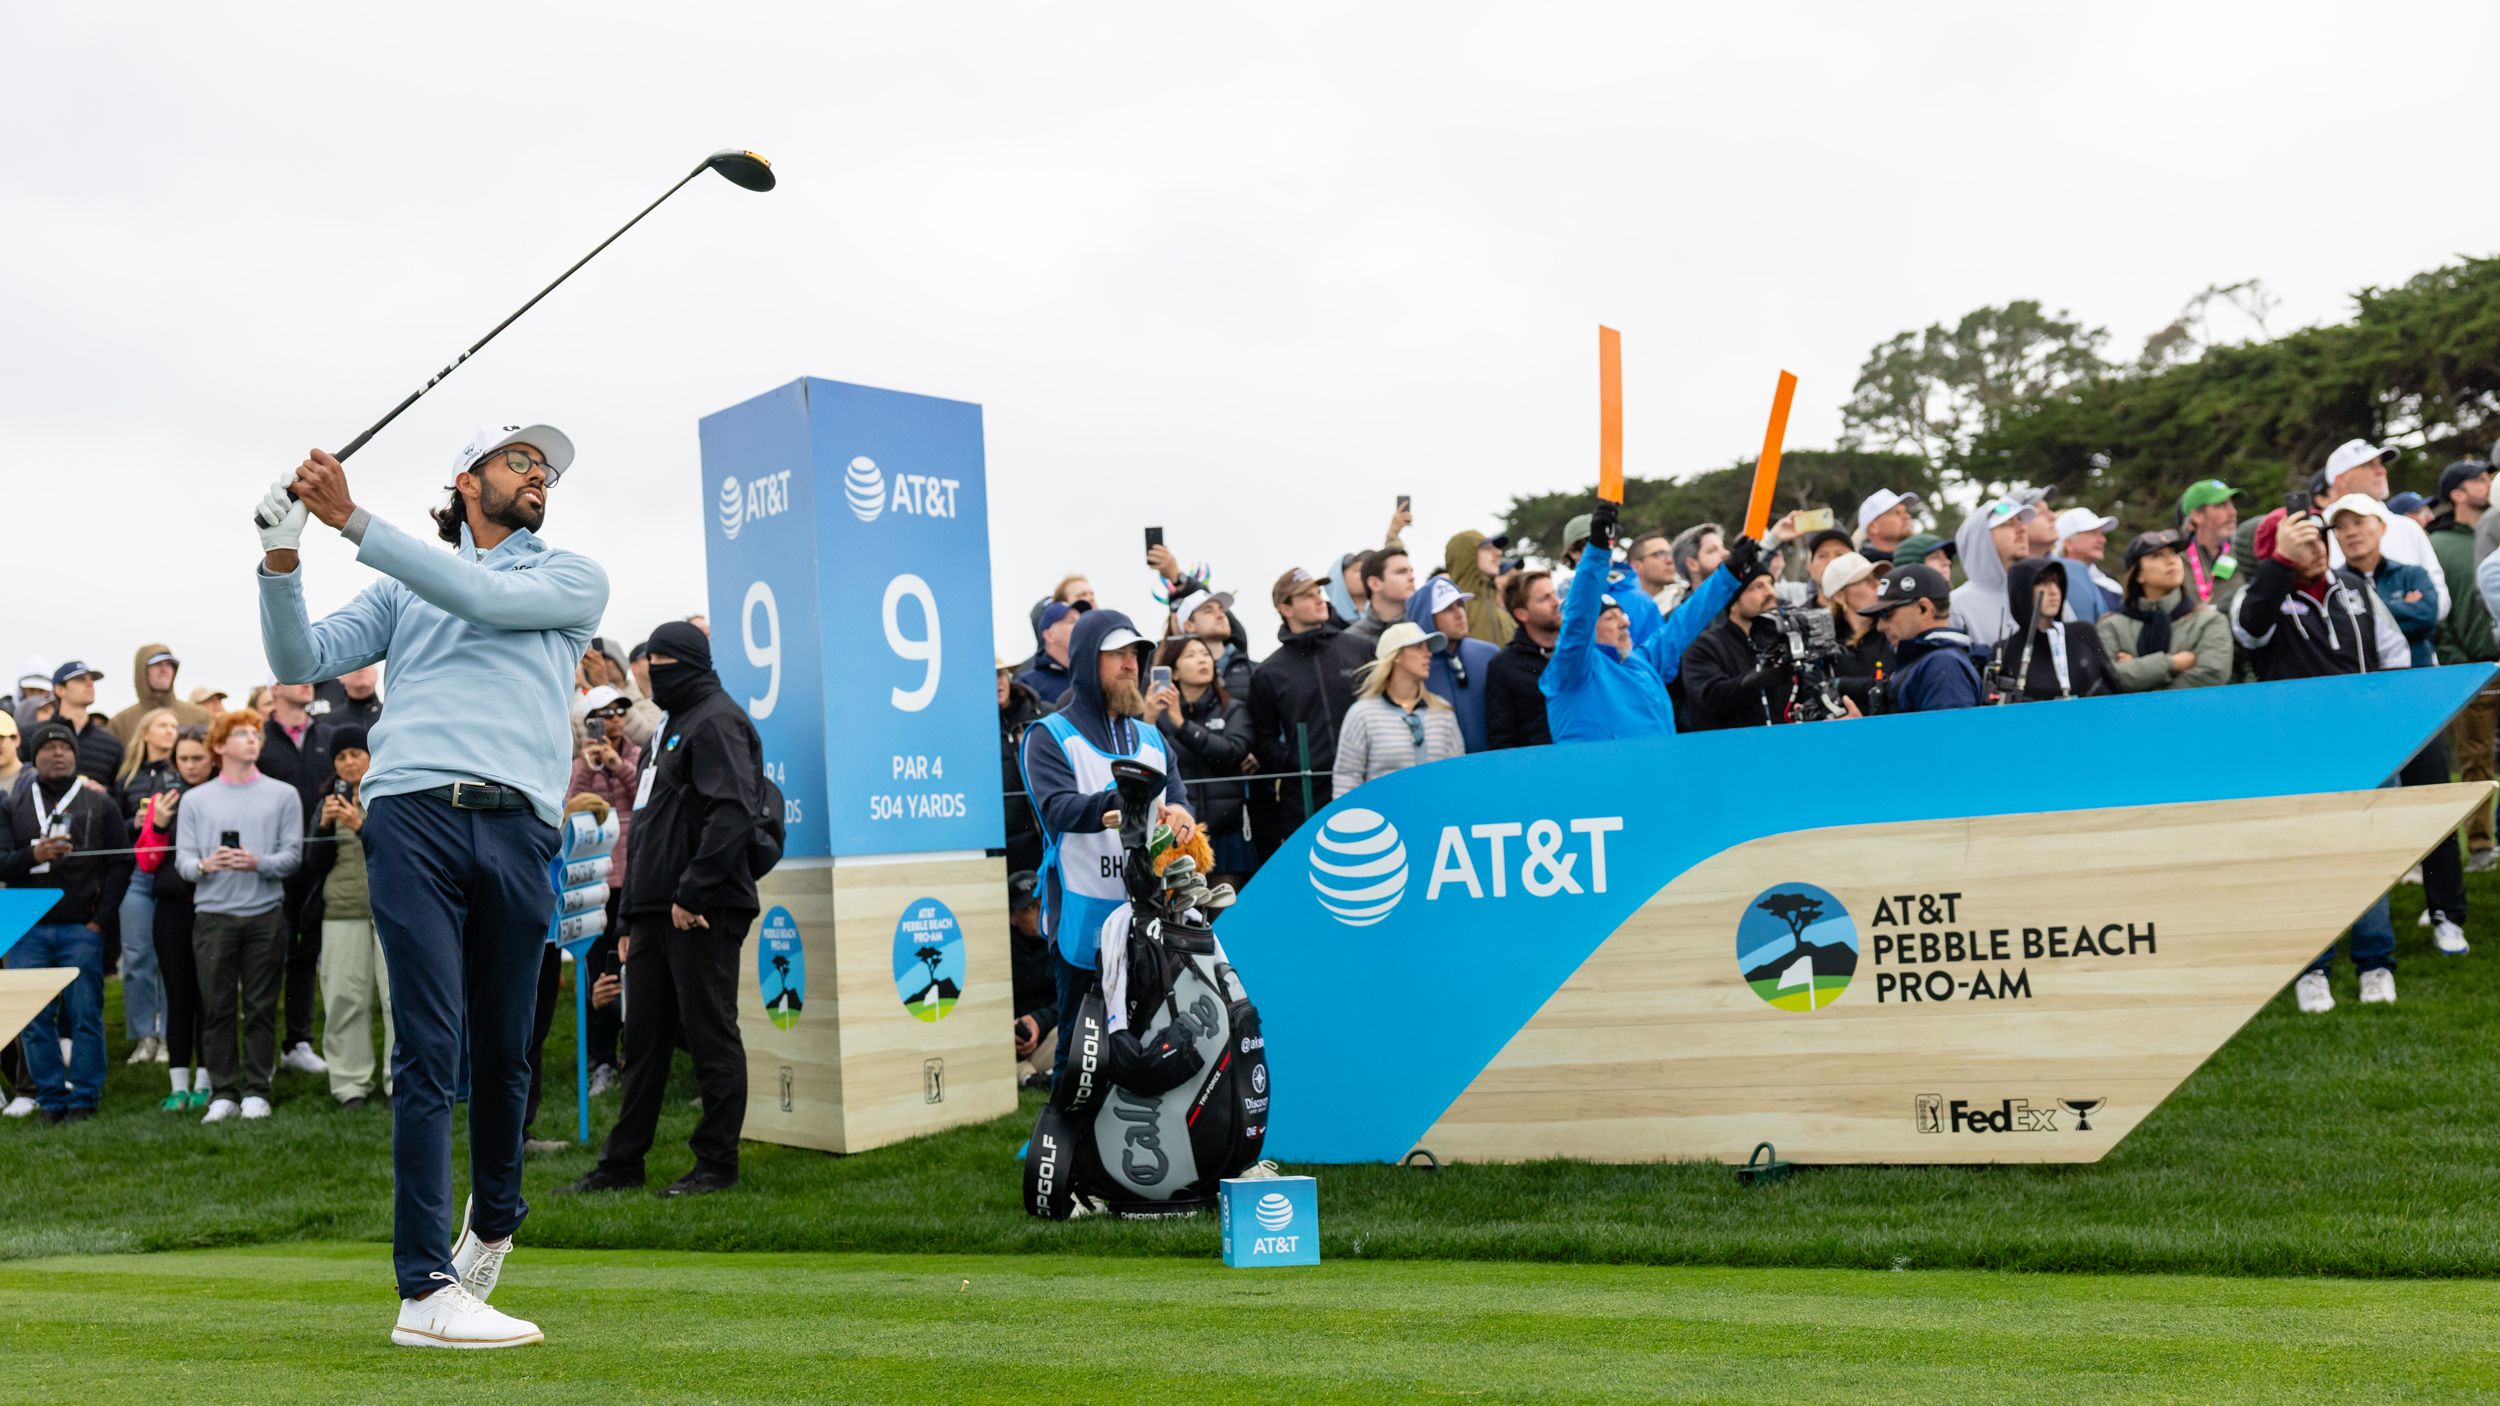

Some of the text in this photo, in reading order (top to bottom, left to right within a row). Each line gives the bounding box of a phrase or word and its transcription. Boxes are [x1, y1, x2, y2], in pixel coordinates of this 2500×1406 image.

[746, 470, 791, 523] AT&T
[890, 473, 960, 519] AT&T
[742, 580, 781, 720] 9
[882, 573, 942, 713] 9
[777, 762, 785, 785] 4
[892, 755, 943, 781] PAR 4
[784, 799, 802, 824] DS
[870, 793, 967, 820] 504 YARDS
[1426, 816, 1624, 901] AT&T
[902, 918, 953, 933] PEBBLE BEACH
[1872, 893, 1962, 927] AT&T
[913, 930, 944, 944] PRO-AM
[1873, 922, 2157, 965] PEBBLE BEACH
[1876, 968, 2032, 1003] PRO-AM
[1073, 1017, 1101, 1105] TOPGOLF
[1199, 1070, 1222, 1106] TRI-FORCE
[1950, 1099, 2058, 1133] FedEx
[1253, 1236, 1299, 1255] AT&T
